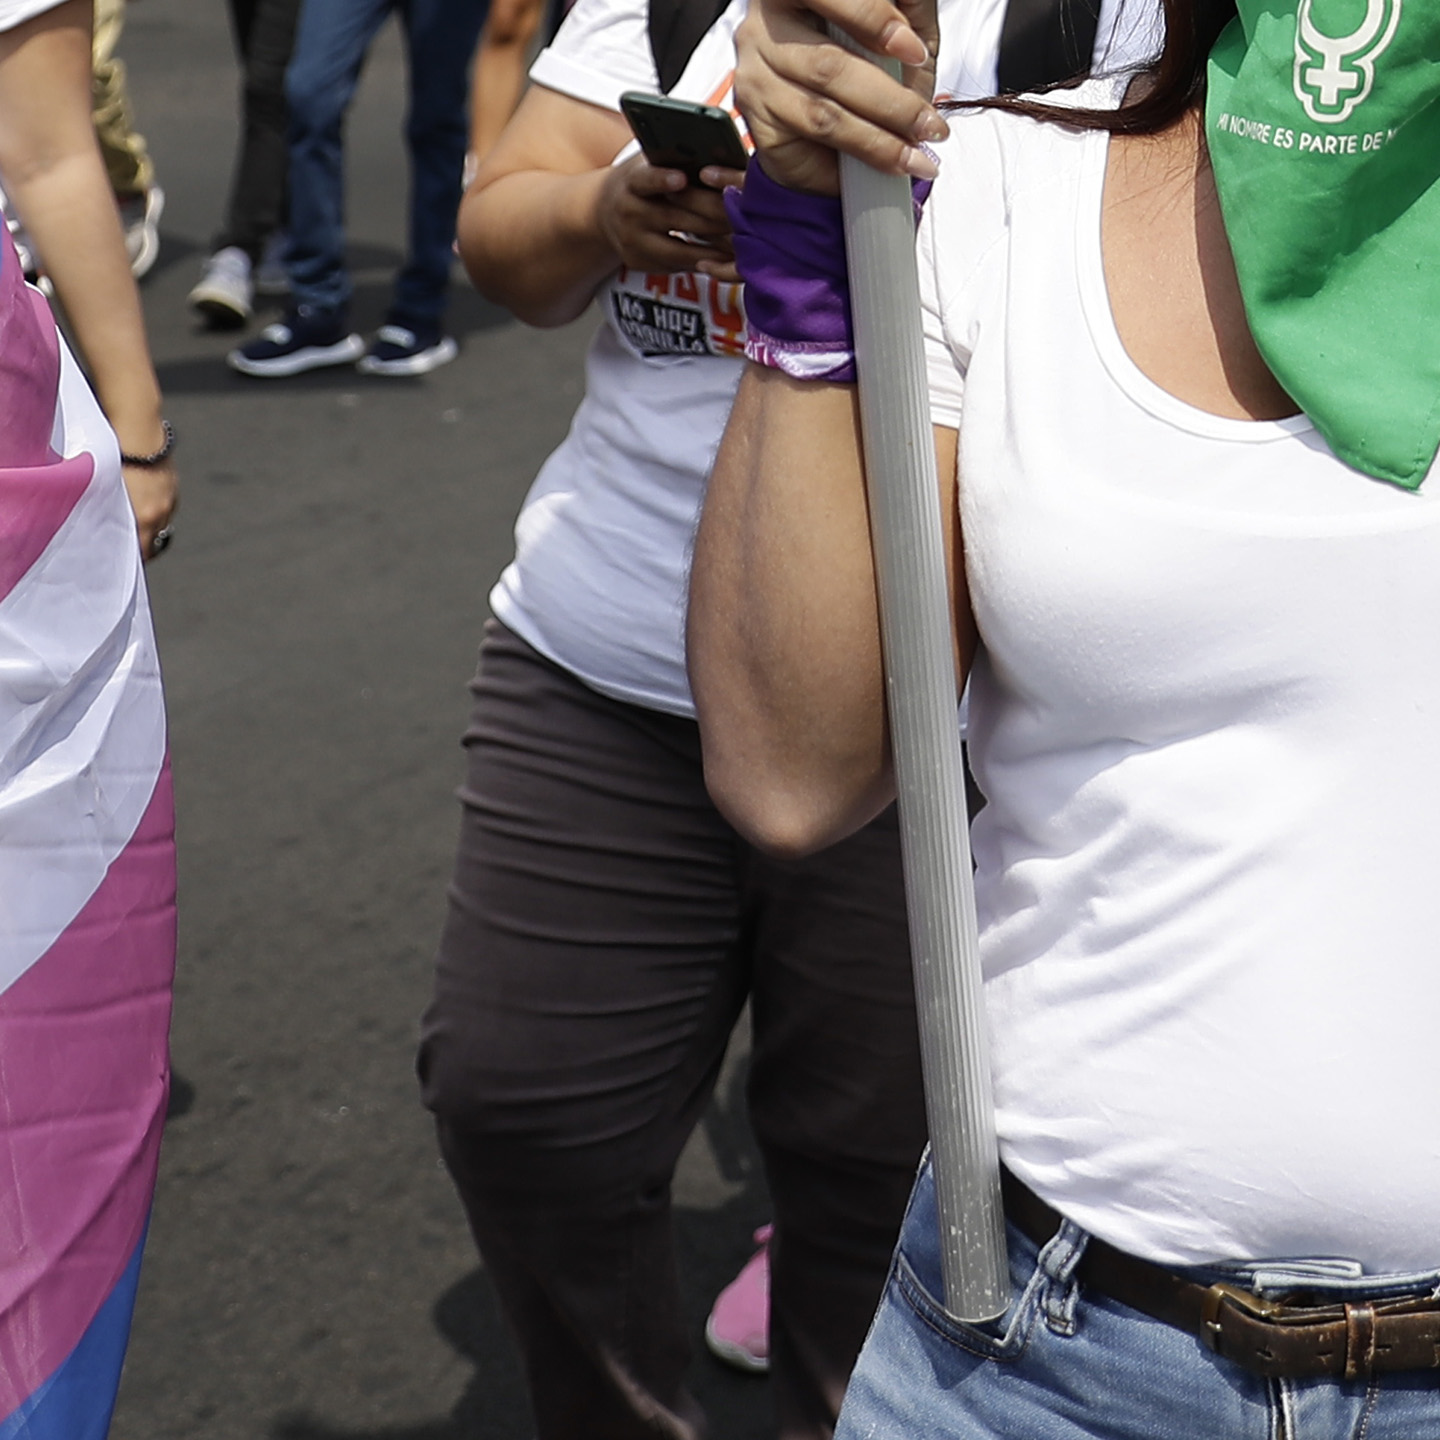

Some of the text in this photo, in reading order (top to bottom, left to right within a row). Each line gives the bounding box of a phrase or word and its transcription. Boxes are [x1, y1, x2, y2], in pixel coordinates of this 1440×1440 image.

[1273, 127, 1295, 149] ES
[1299, 132, 1359, 155] PARTE
[1362, 131, 1384, 152] DE
